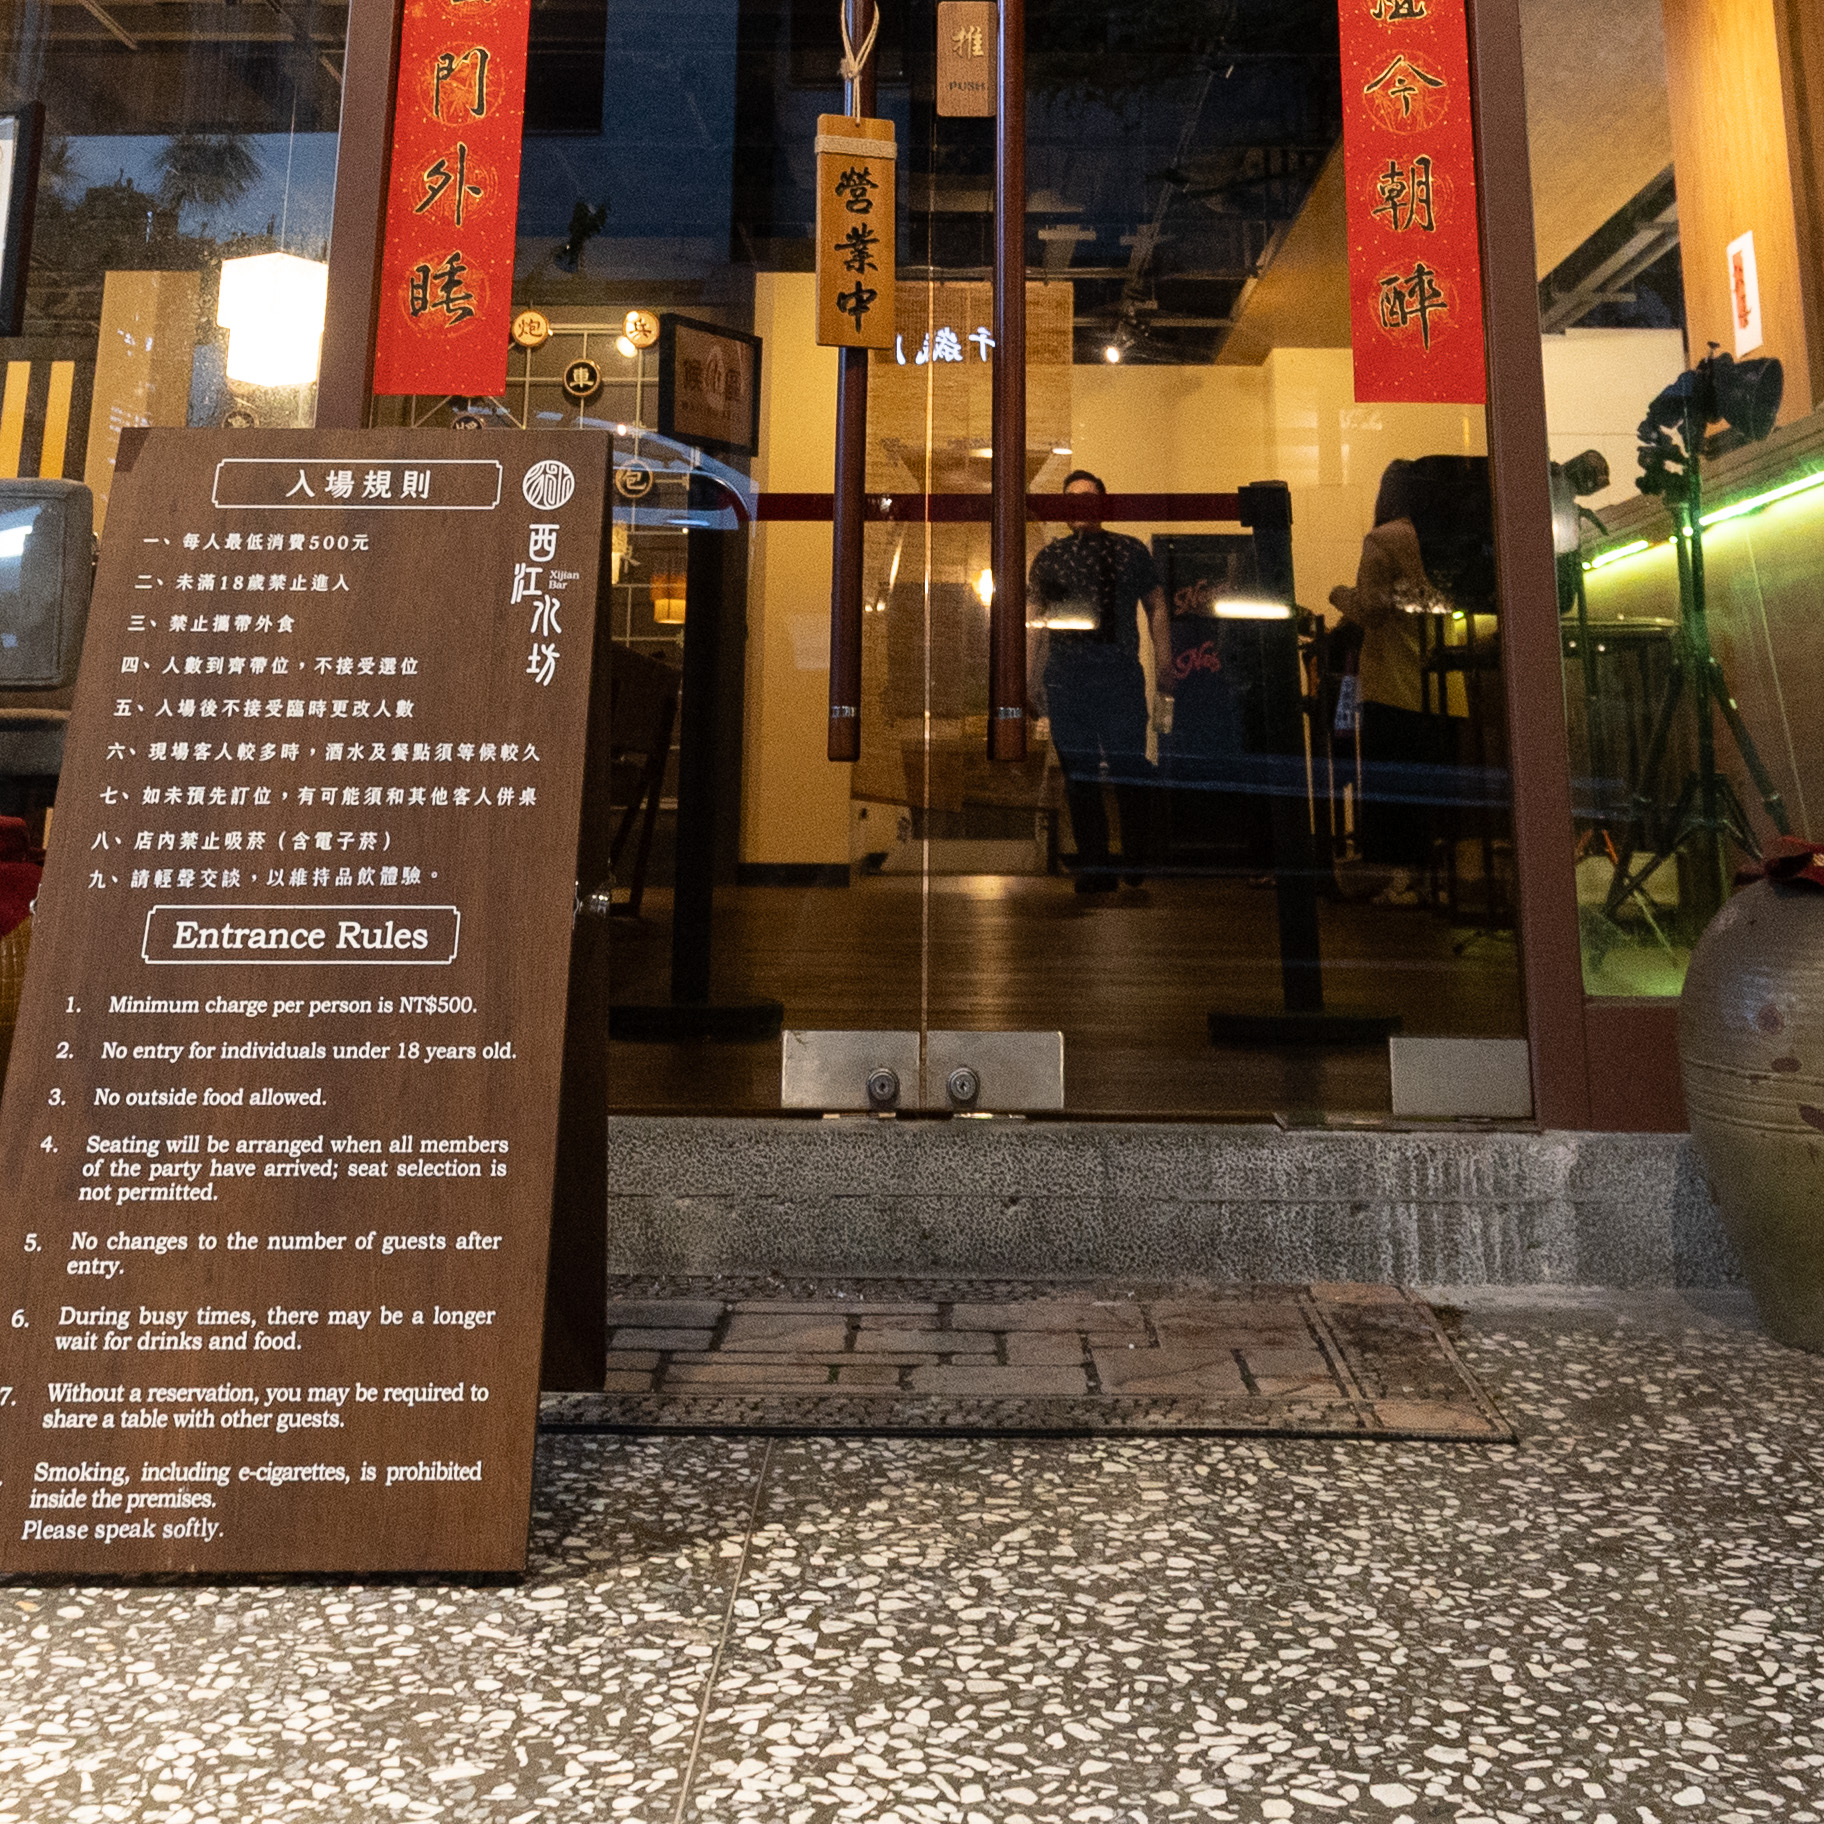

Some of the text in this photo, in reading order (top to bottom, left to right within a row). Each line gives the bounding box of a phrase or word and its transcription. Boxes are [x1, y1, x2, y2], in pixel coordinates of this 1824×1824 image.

[950, 24, 985, 60] 推
[948, 80, 986, 92] PUSH
[833, 165, 881, 335] 營業中
[517, 318, 544, 338] 炮
[569, 366, 594, 388] 車
[548, 580, 568, 590] Bar
[510, 523, 563, 687] 西江水坊
[172, 920, 429, 950] Entrance Rules
[66, 995, 477, 1018] 1. Minimum charge per person is NT$500.
[55, 1041, 517, 1064] 2. No entry for individuals under 18 years old.
[48, 1087, 327, 1106] 3. No outside food allowed.
[40, 1134, 509, 1158] 4. Seating will be arranged when all members
[82, 1158, 507, 1182] of the party have arrived; seat selection is
[78, 1182, 218, 1206] not permitted.
[23, 1230, 503, 1255] 5. No changes to the number of guests after
[66, 1257, 124, 1280] entry.
[11, 1305, 496, 1331] 6. During busy times, there may be a longer
[55, 1330, 302, 1351] wait for drinks and food.
[0, 1382, 489, 1407] 7. Without a reservation, you may be required to
[42, 1408, 345, 1433] share a table with other guests.
[33, 1461, 130, 1487] Smoking,
[140, 1461, 231, 1487] including
[238, 1461, 350, 1487] e-cigarettes,
[360, 1461, 377, 1481] is
[385, 1460, 482, 1487] prohibited
[29, 1487, 217, 1514] inside the premises.
[21, 1519, 89, 1540] Please
[94, 1517, 156, 1545] speak
[162, 1516, 224, 1543] softly.
